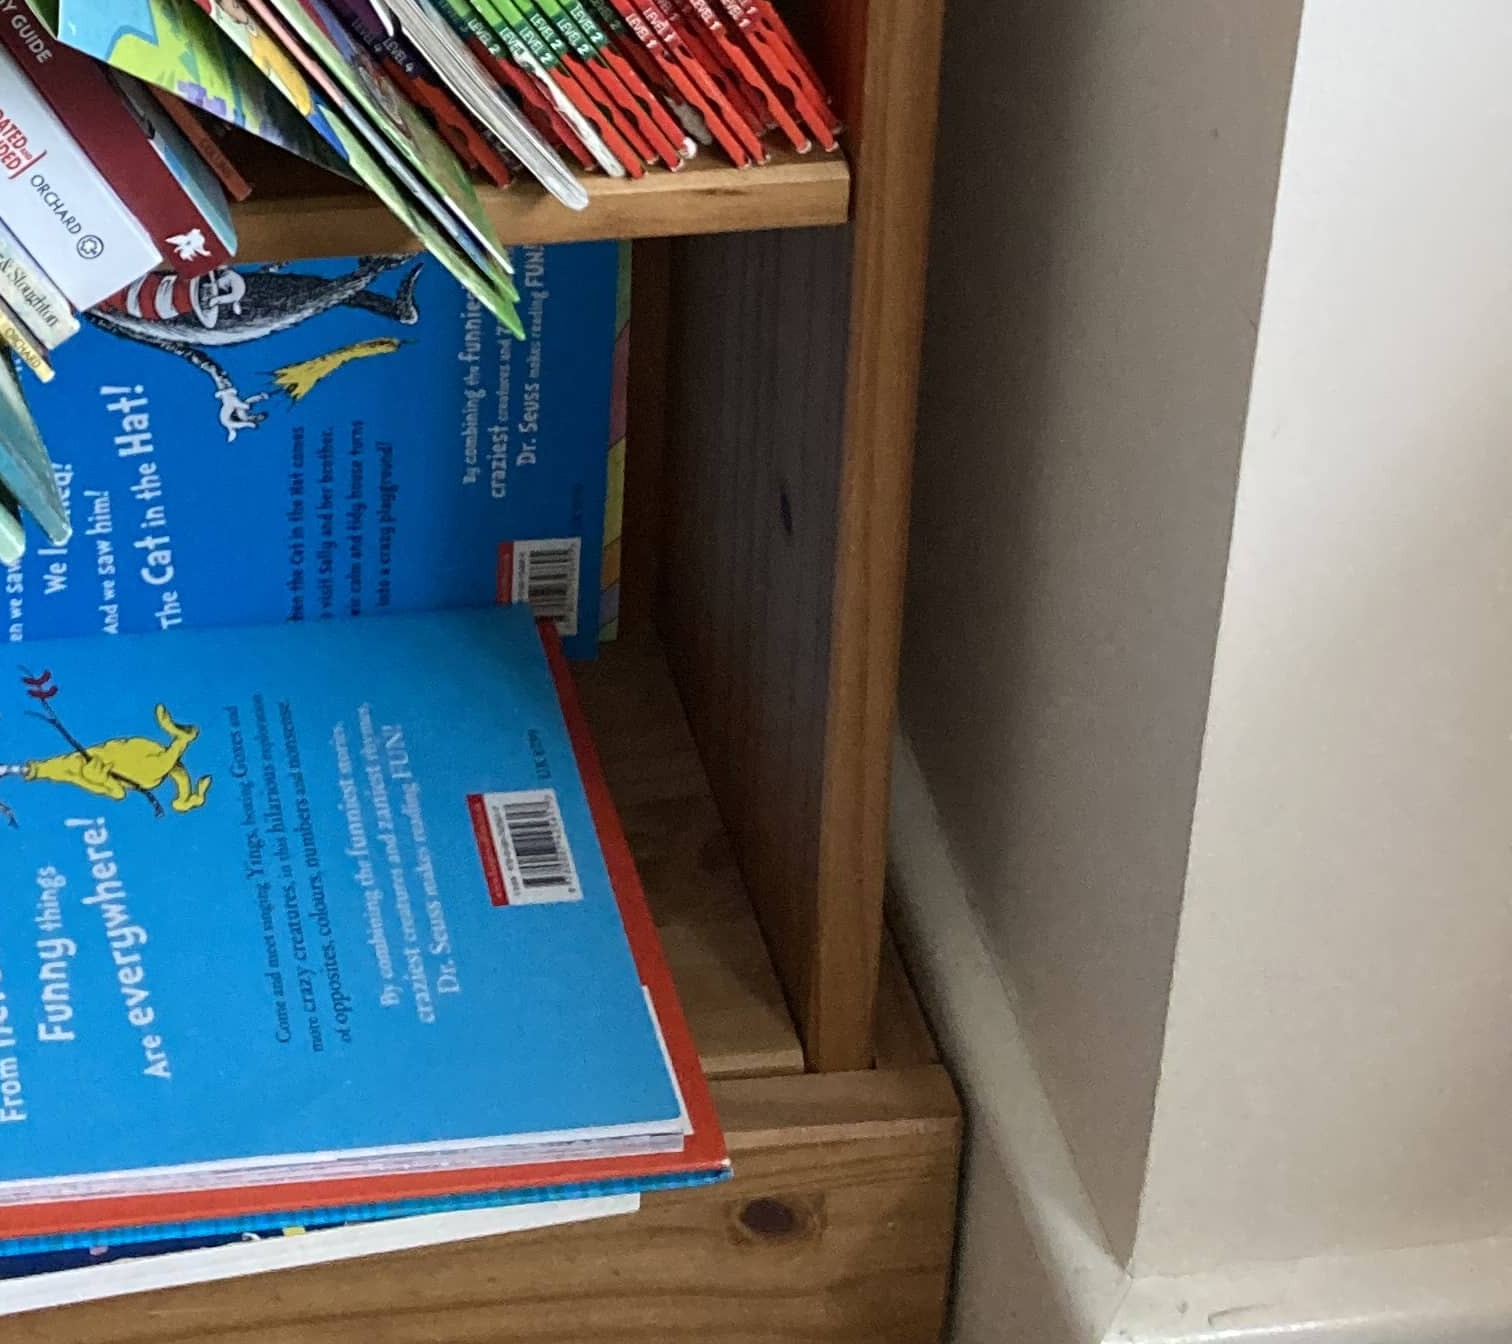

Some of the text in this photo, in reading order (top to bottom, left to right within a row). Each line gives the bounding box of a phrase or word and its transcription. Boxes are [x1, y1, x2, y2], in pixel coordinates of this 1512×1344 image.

[11, 9, 53, 63] GUIDE
[30, 174, 82, 235] ORCHARD
[85, 490, 117, 634] And we saw him!
[101, 386, 180, 628] The Cat in the Hat!
[34, 867, 77, 1041] Funny things
[64, 817, 172, 1079] Are everywhere!
